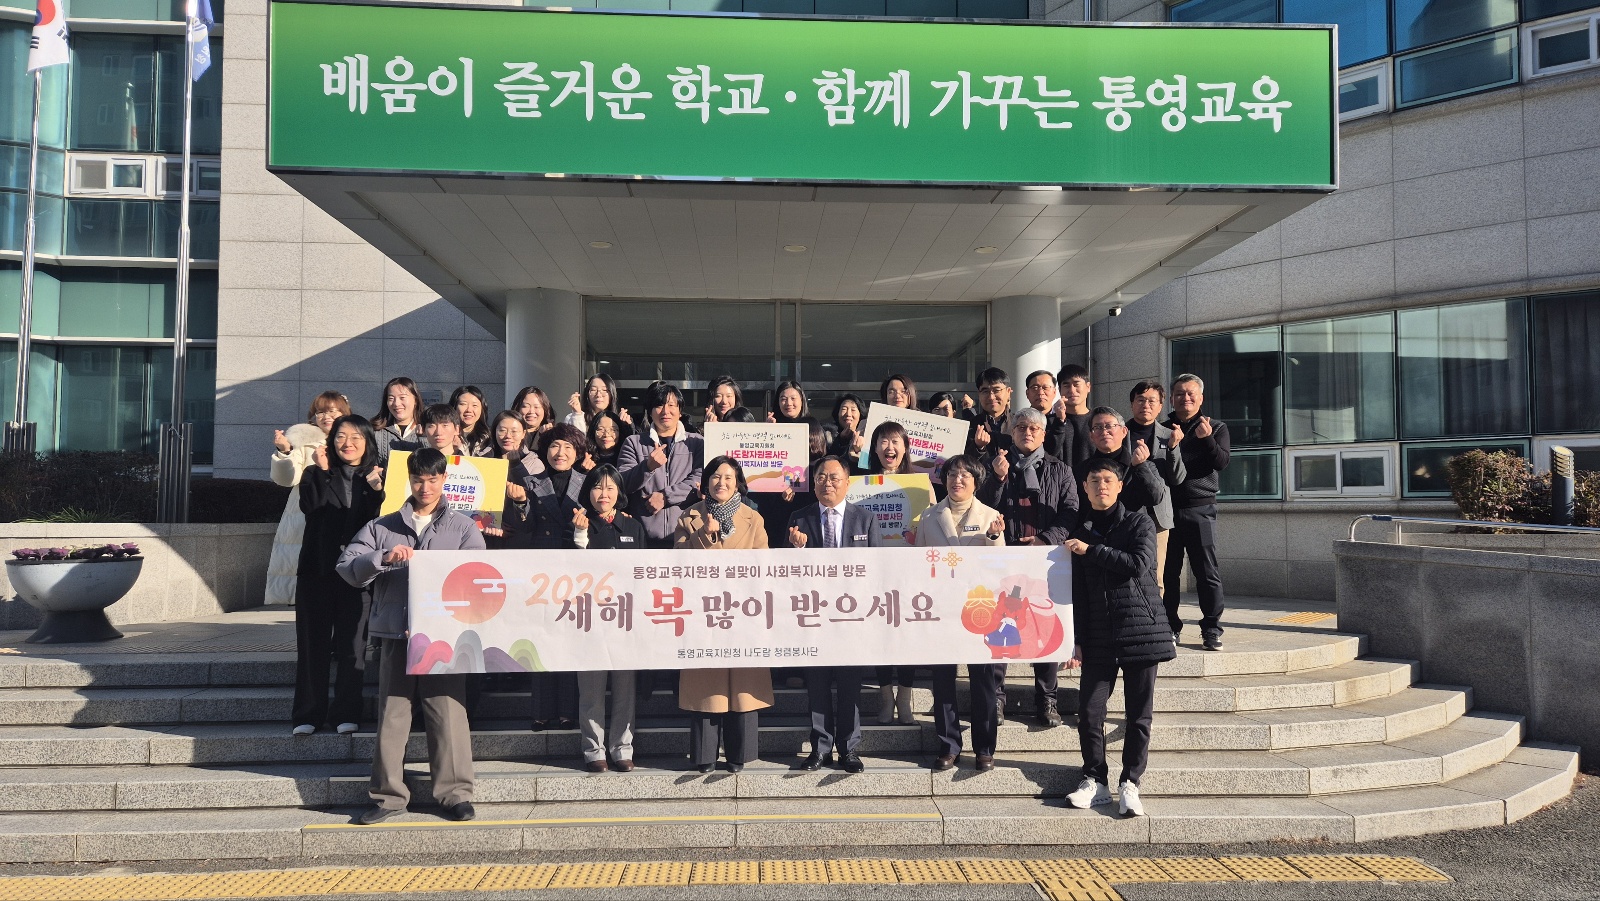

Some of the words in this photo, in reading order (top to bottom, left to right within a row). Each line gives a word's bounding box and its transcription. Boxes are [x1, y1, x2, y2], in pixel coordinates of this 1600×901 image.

[319, 53, 474, 118] 배움이
[493, 60, 653, 122] 즐거운
[666, 64, 770, 124] 학교
[812, 67, 910, 129] 함께
[929, 70, 1080, 131] 가꾸는
[1091, 74, 1293, 133] 통영교육
[525, 571, 614, 607] 2026
[632, 565, 720, 580] 통영교육지원청
[724, 565, 762, 579] 설맞이
[765, 564, 838, 578] 사회복지시설
[842, 564, 867, 578] 방문
[555, 591, 634, 633] 새해
[644, 586, 693, 637] 복
[701, 590, 774, 630] 많이
[789, 589, 941, 628] 받으세요
[677, 648, 741, 659] 통영교육지원청
[744, 647, 771, 658] 나도람
